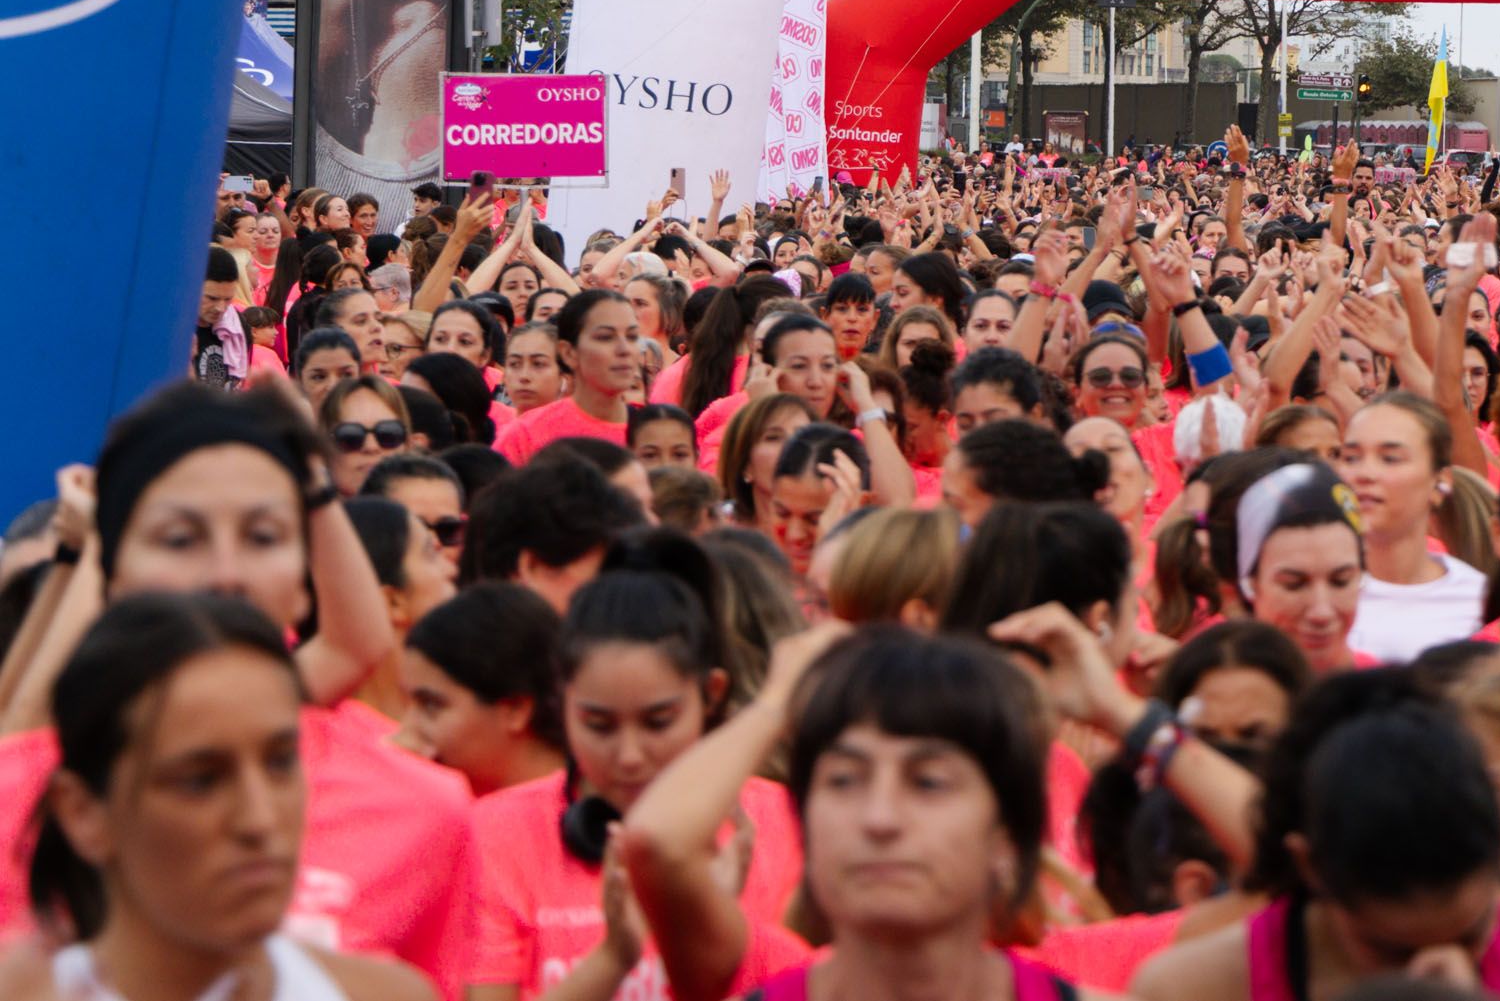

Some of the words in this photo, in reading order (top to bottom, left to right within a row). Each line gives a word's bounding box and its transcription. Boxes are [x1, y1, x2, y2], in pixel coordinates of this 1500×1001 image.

[537, 86, 601, 102] OYSHO
[588, 70, 733, 116] YSHO
[834, 100, 884, 119] Sports
[446, 121, 603, 146] CORREDORAS
[829, 125, 902, 144] Santander
